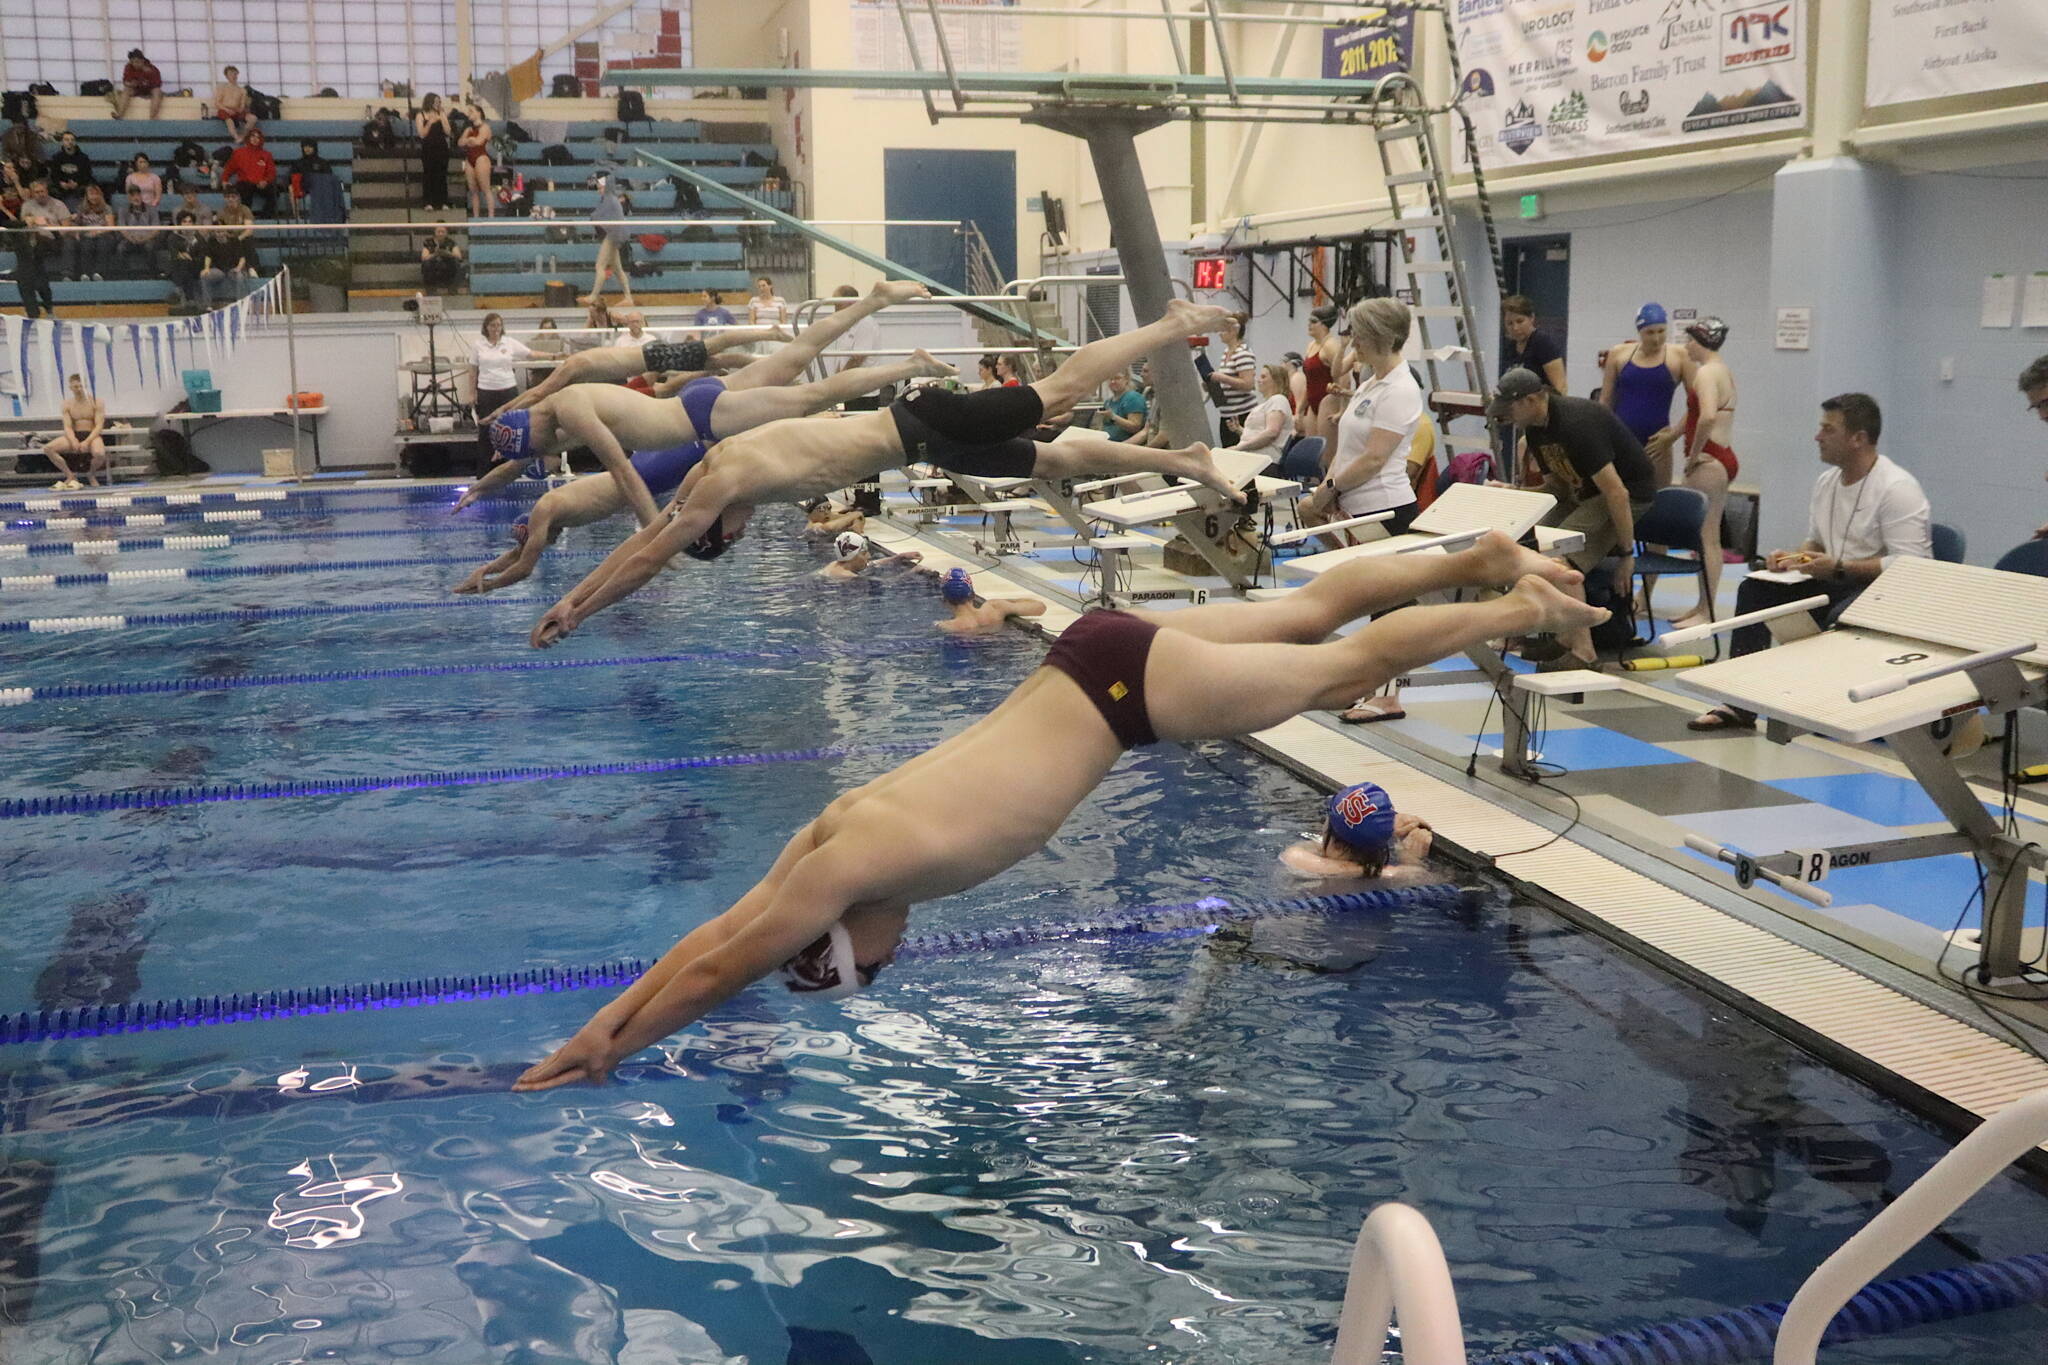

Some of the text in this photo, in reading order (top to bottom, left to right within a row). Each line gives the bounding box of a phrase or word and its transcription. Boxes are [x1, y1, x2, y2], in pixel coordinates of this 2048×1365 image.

[1521, 8, 1575, 34] UROLOGY
[1508, 57, 1554, 76] MERRILL
[1631, 60, 1670, 83] Family
[1673, 56, 1706, 75] Trust
[948, 506, 954, 515] 4
[1205, 514, 1219, 538] 6
[1132, 590, 1206, 605] PARAGON 6
[1886, 653, 1929, 665] 8
[1739, 859, 1750, 884] 8
[1808, 851, 1871, 882] 8 AGON
